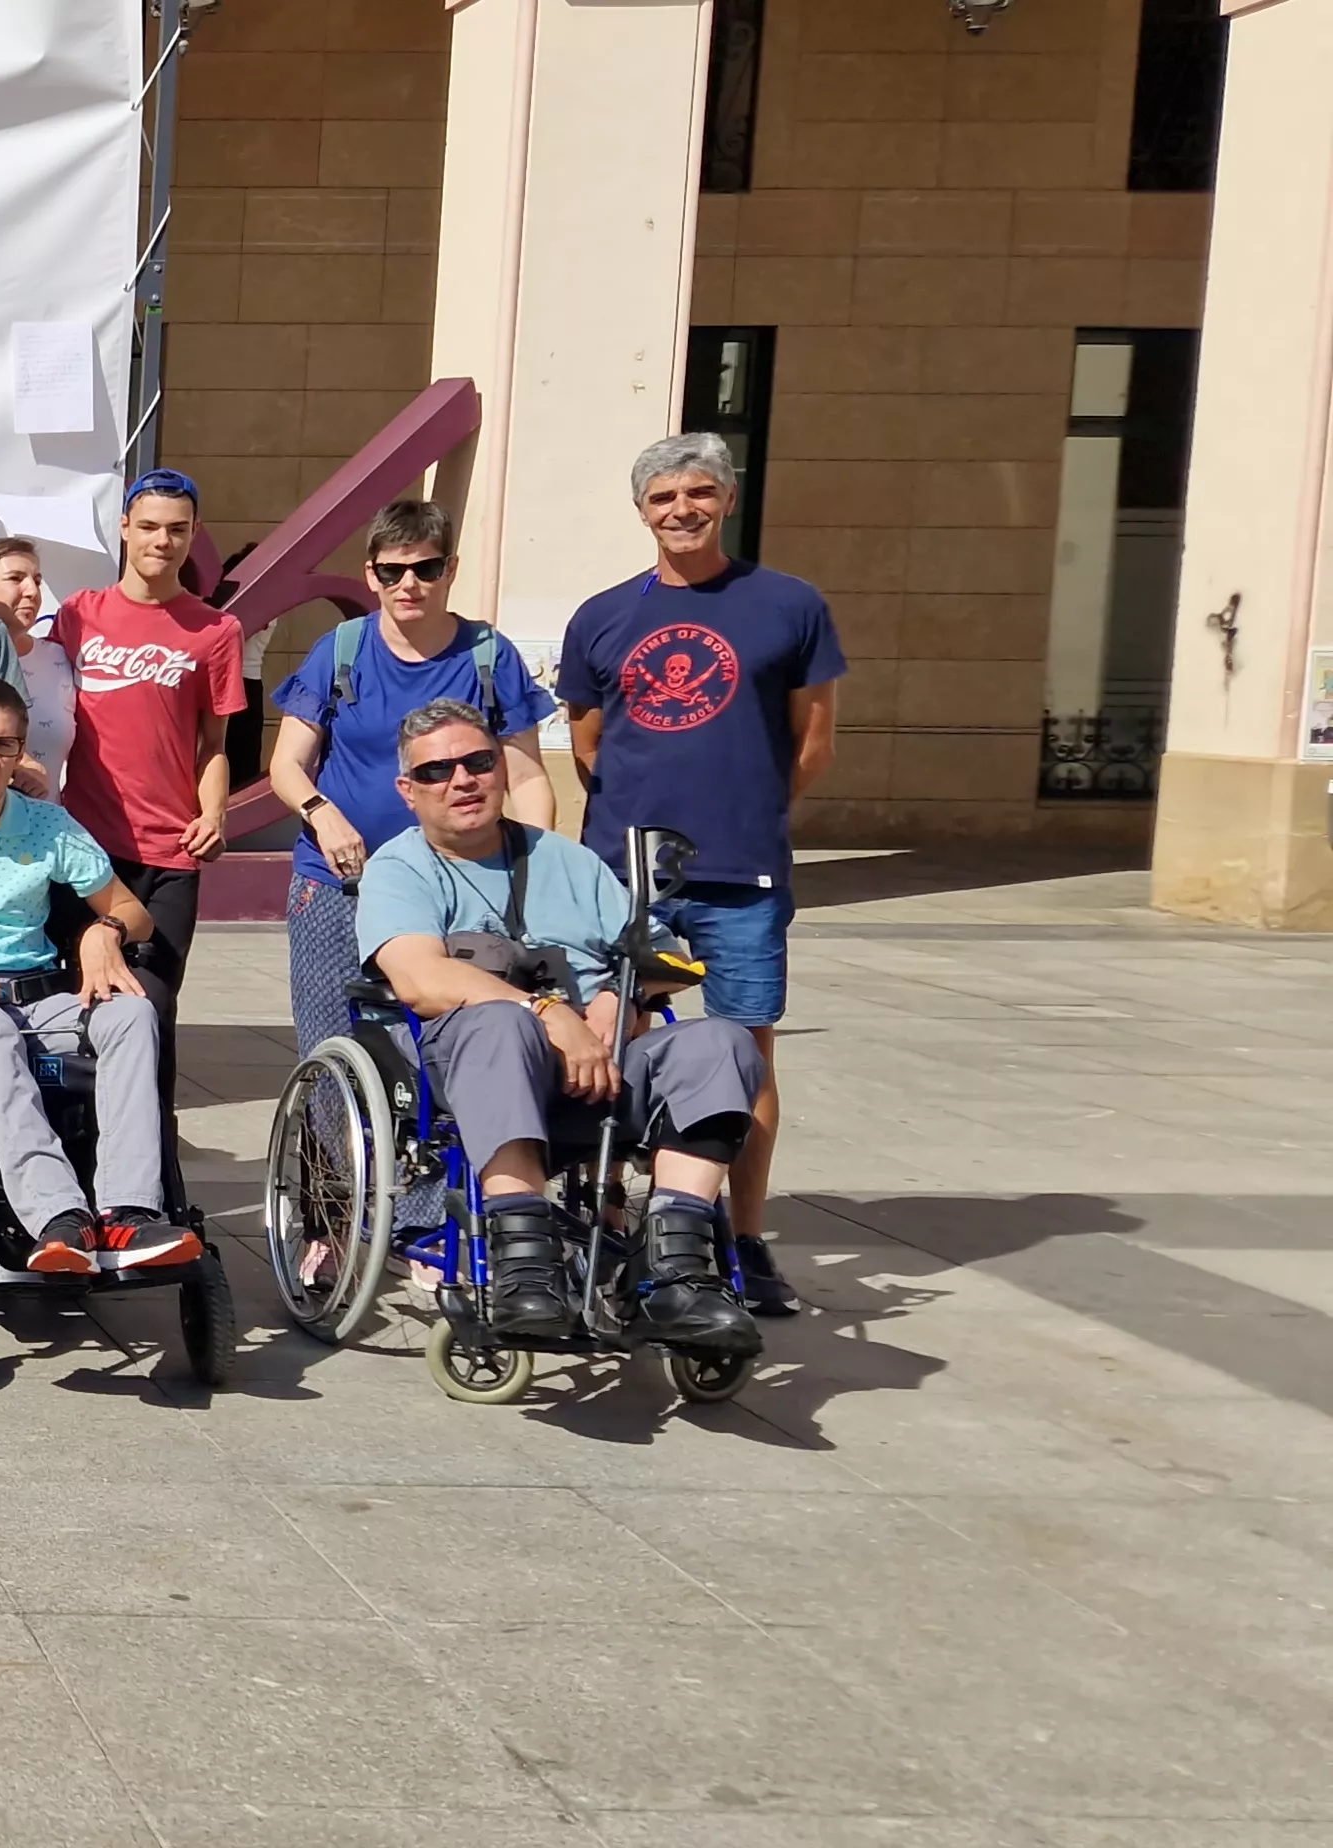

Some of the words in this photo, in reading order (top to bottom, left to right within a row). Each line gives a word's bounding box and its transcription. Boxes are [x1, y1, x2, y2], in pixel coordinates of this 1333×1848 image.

[76, 635, 197, 692] Coca-Cola
[634, 632, 671, 661] TIME
[677, 629, 700, 639] OF
[702, 635, 734, 682] BOCHA
[633, 704, 672, 727] SINCE
